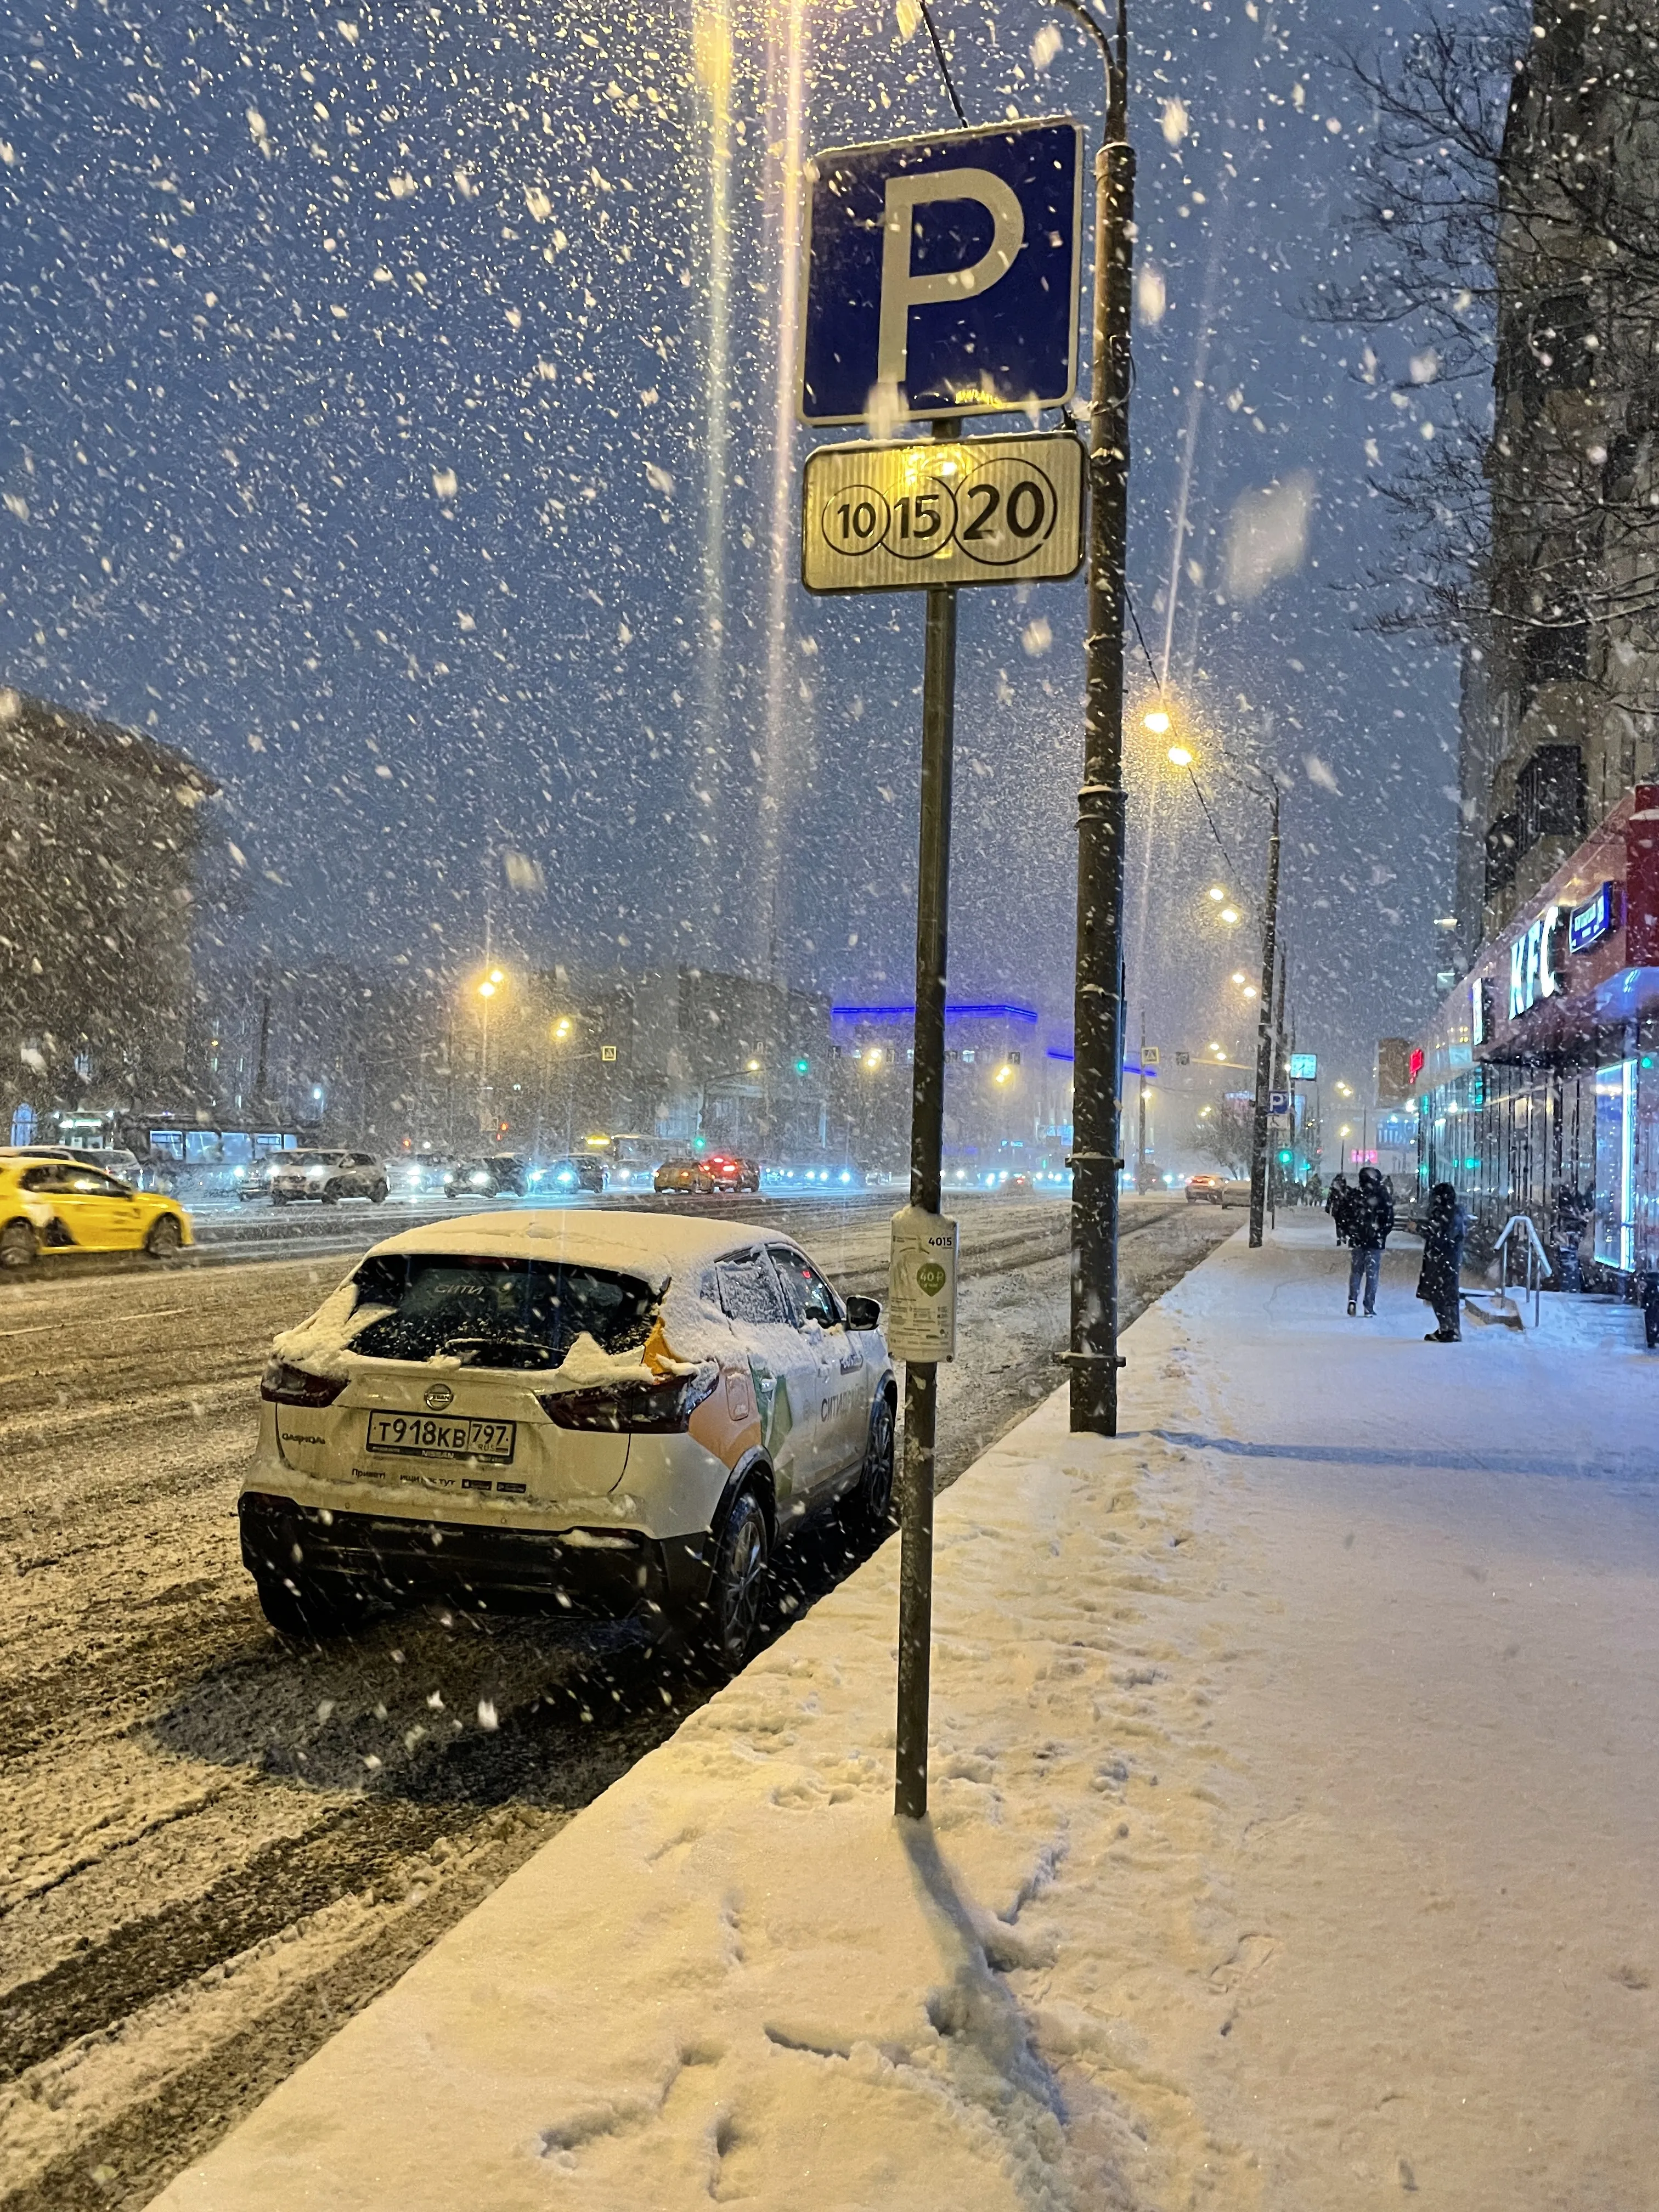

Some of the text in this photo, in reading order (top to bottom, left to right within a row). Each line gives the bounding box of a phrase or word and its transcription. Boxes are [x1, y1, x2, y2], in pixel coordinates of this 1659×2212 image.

[878, 168, 1025, 383] P
[837, 481, 1045, 541] 10 15 20
[1509, 906, 1559, 1020] KFC
[1269, 1093, 1284, 1112] P
[928, 1237, 952, 1246] 4015
[920, 1272, 934, 1282] 40
[472, 1424, 507, 1445] 797
[478, 1443, 495, 1452] RUS
